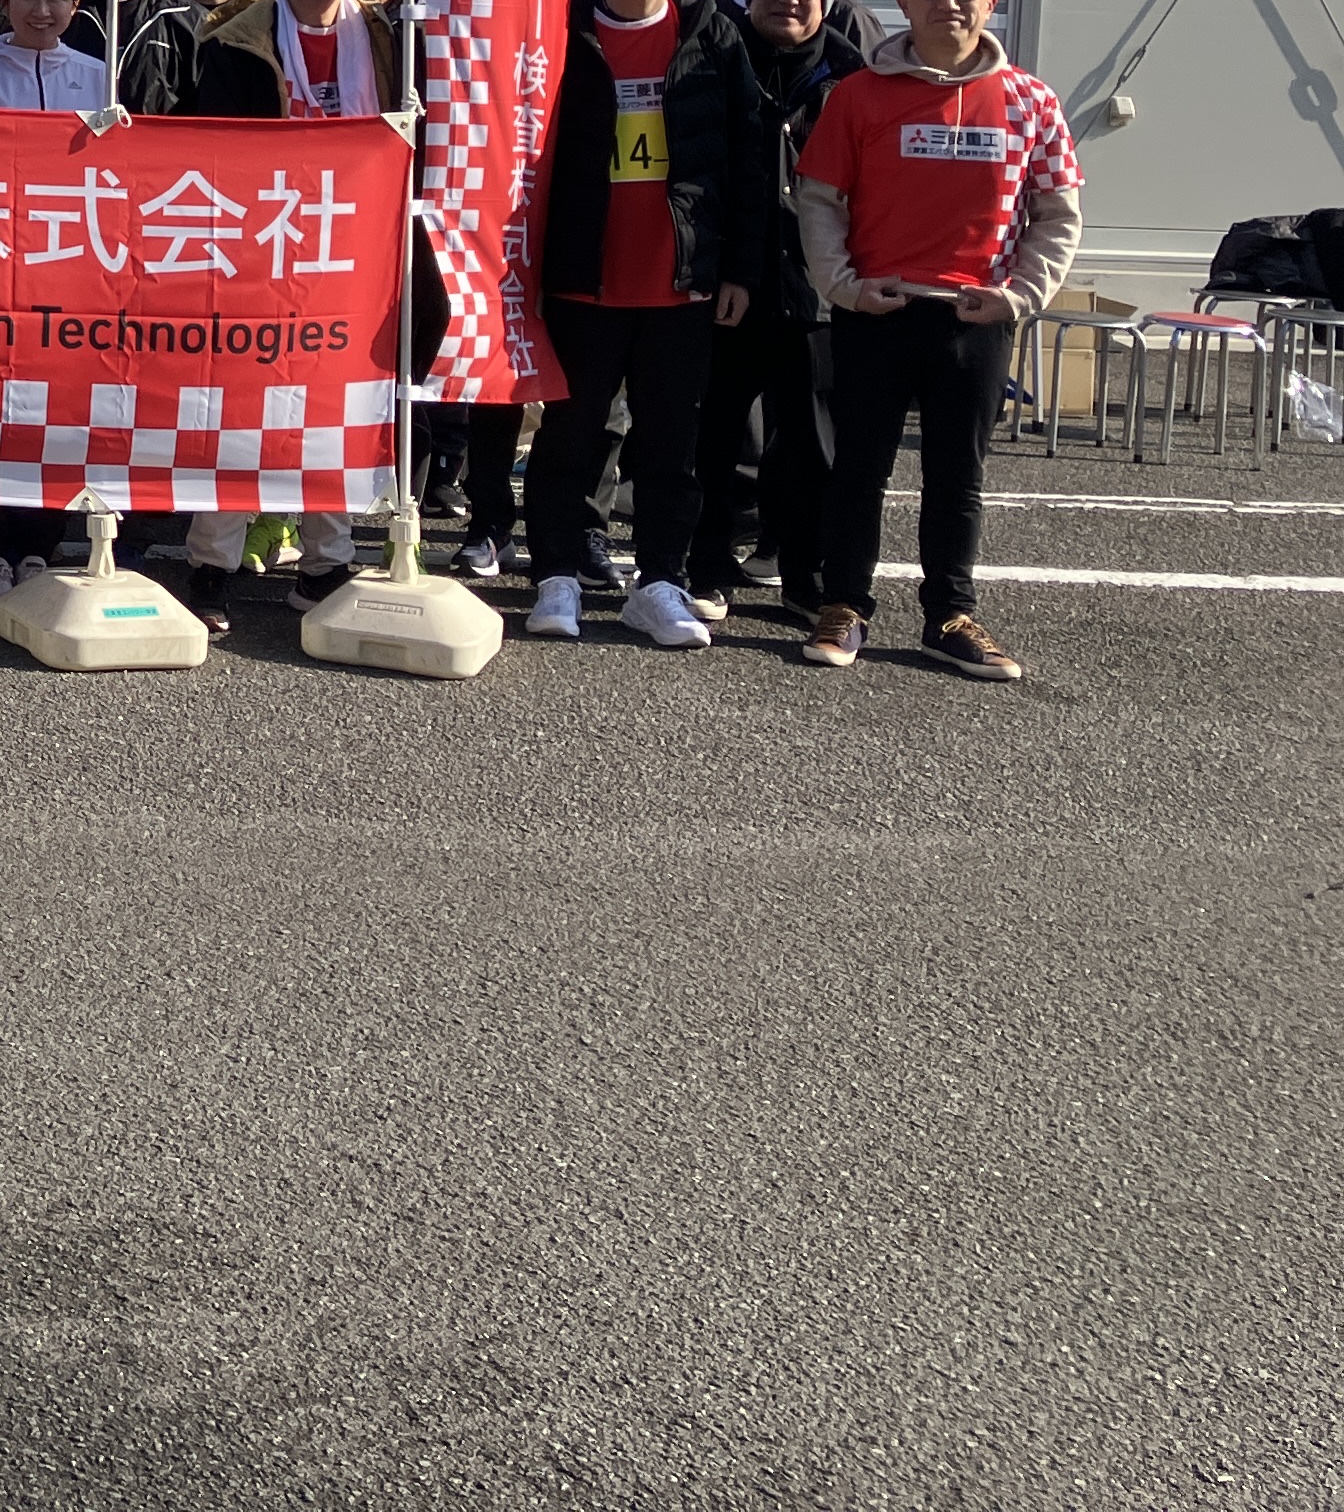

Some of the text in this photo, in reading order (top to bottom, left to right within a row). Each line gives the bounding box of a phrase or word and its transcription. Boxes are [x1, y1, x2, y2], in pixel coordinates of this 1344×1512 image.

[930, 130, 999, 147] 三菱重工
[37, 305, 350, 365] Technologies
